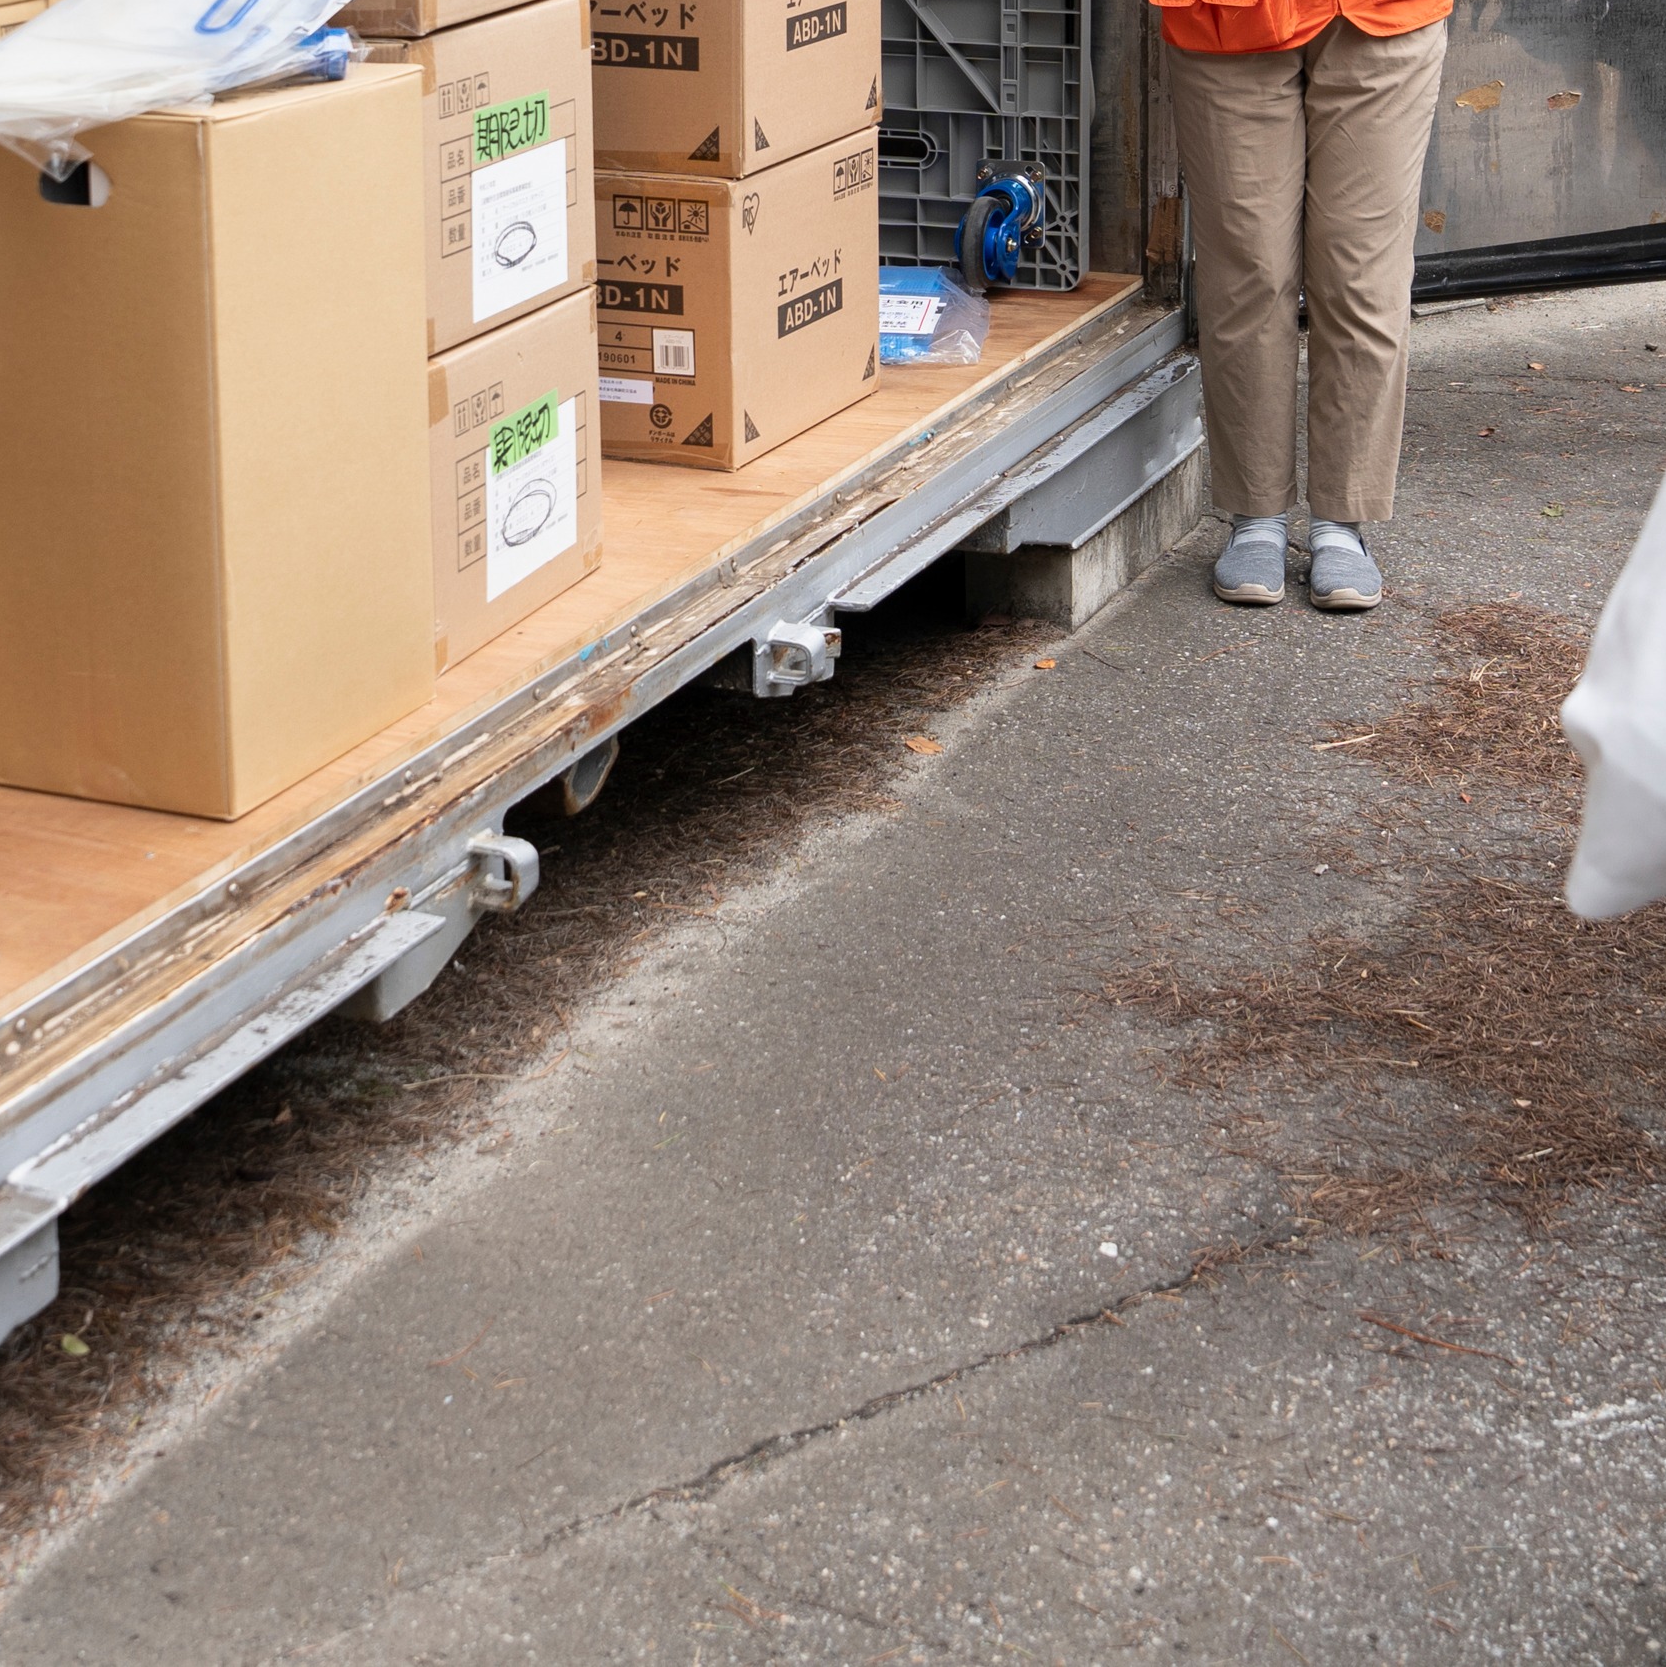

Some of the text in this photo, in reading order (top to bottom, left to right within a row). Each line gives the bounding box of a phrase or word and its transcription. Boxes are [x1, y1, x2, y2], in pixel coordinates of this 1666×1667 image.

[792, 8, 842, 46] ABD-1N
[777, 247, 843, 298] エアーベッド
[784, 286, 837, 332] ABD-1N
[614, 330, 624, 342] 4
[655, 376, 697, 387] MADE IN CHINA
